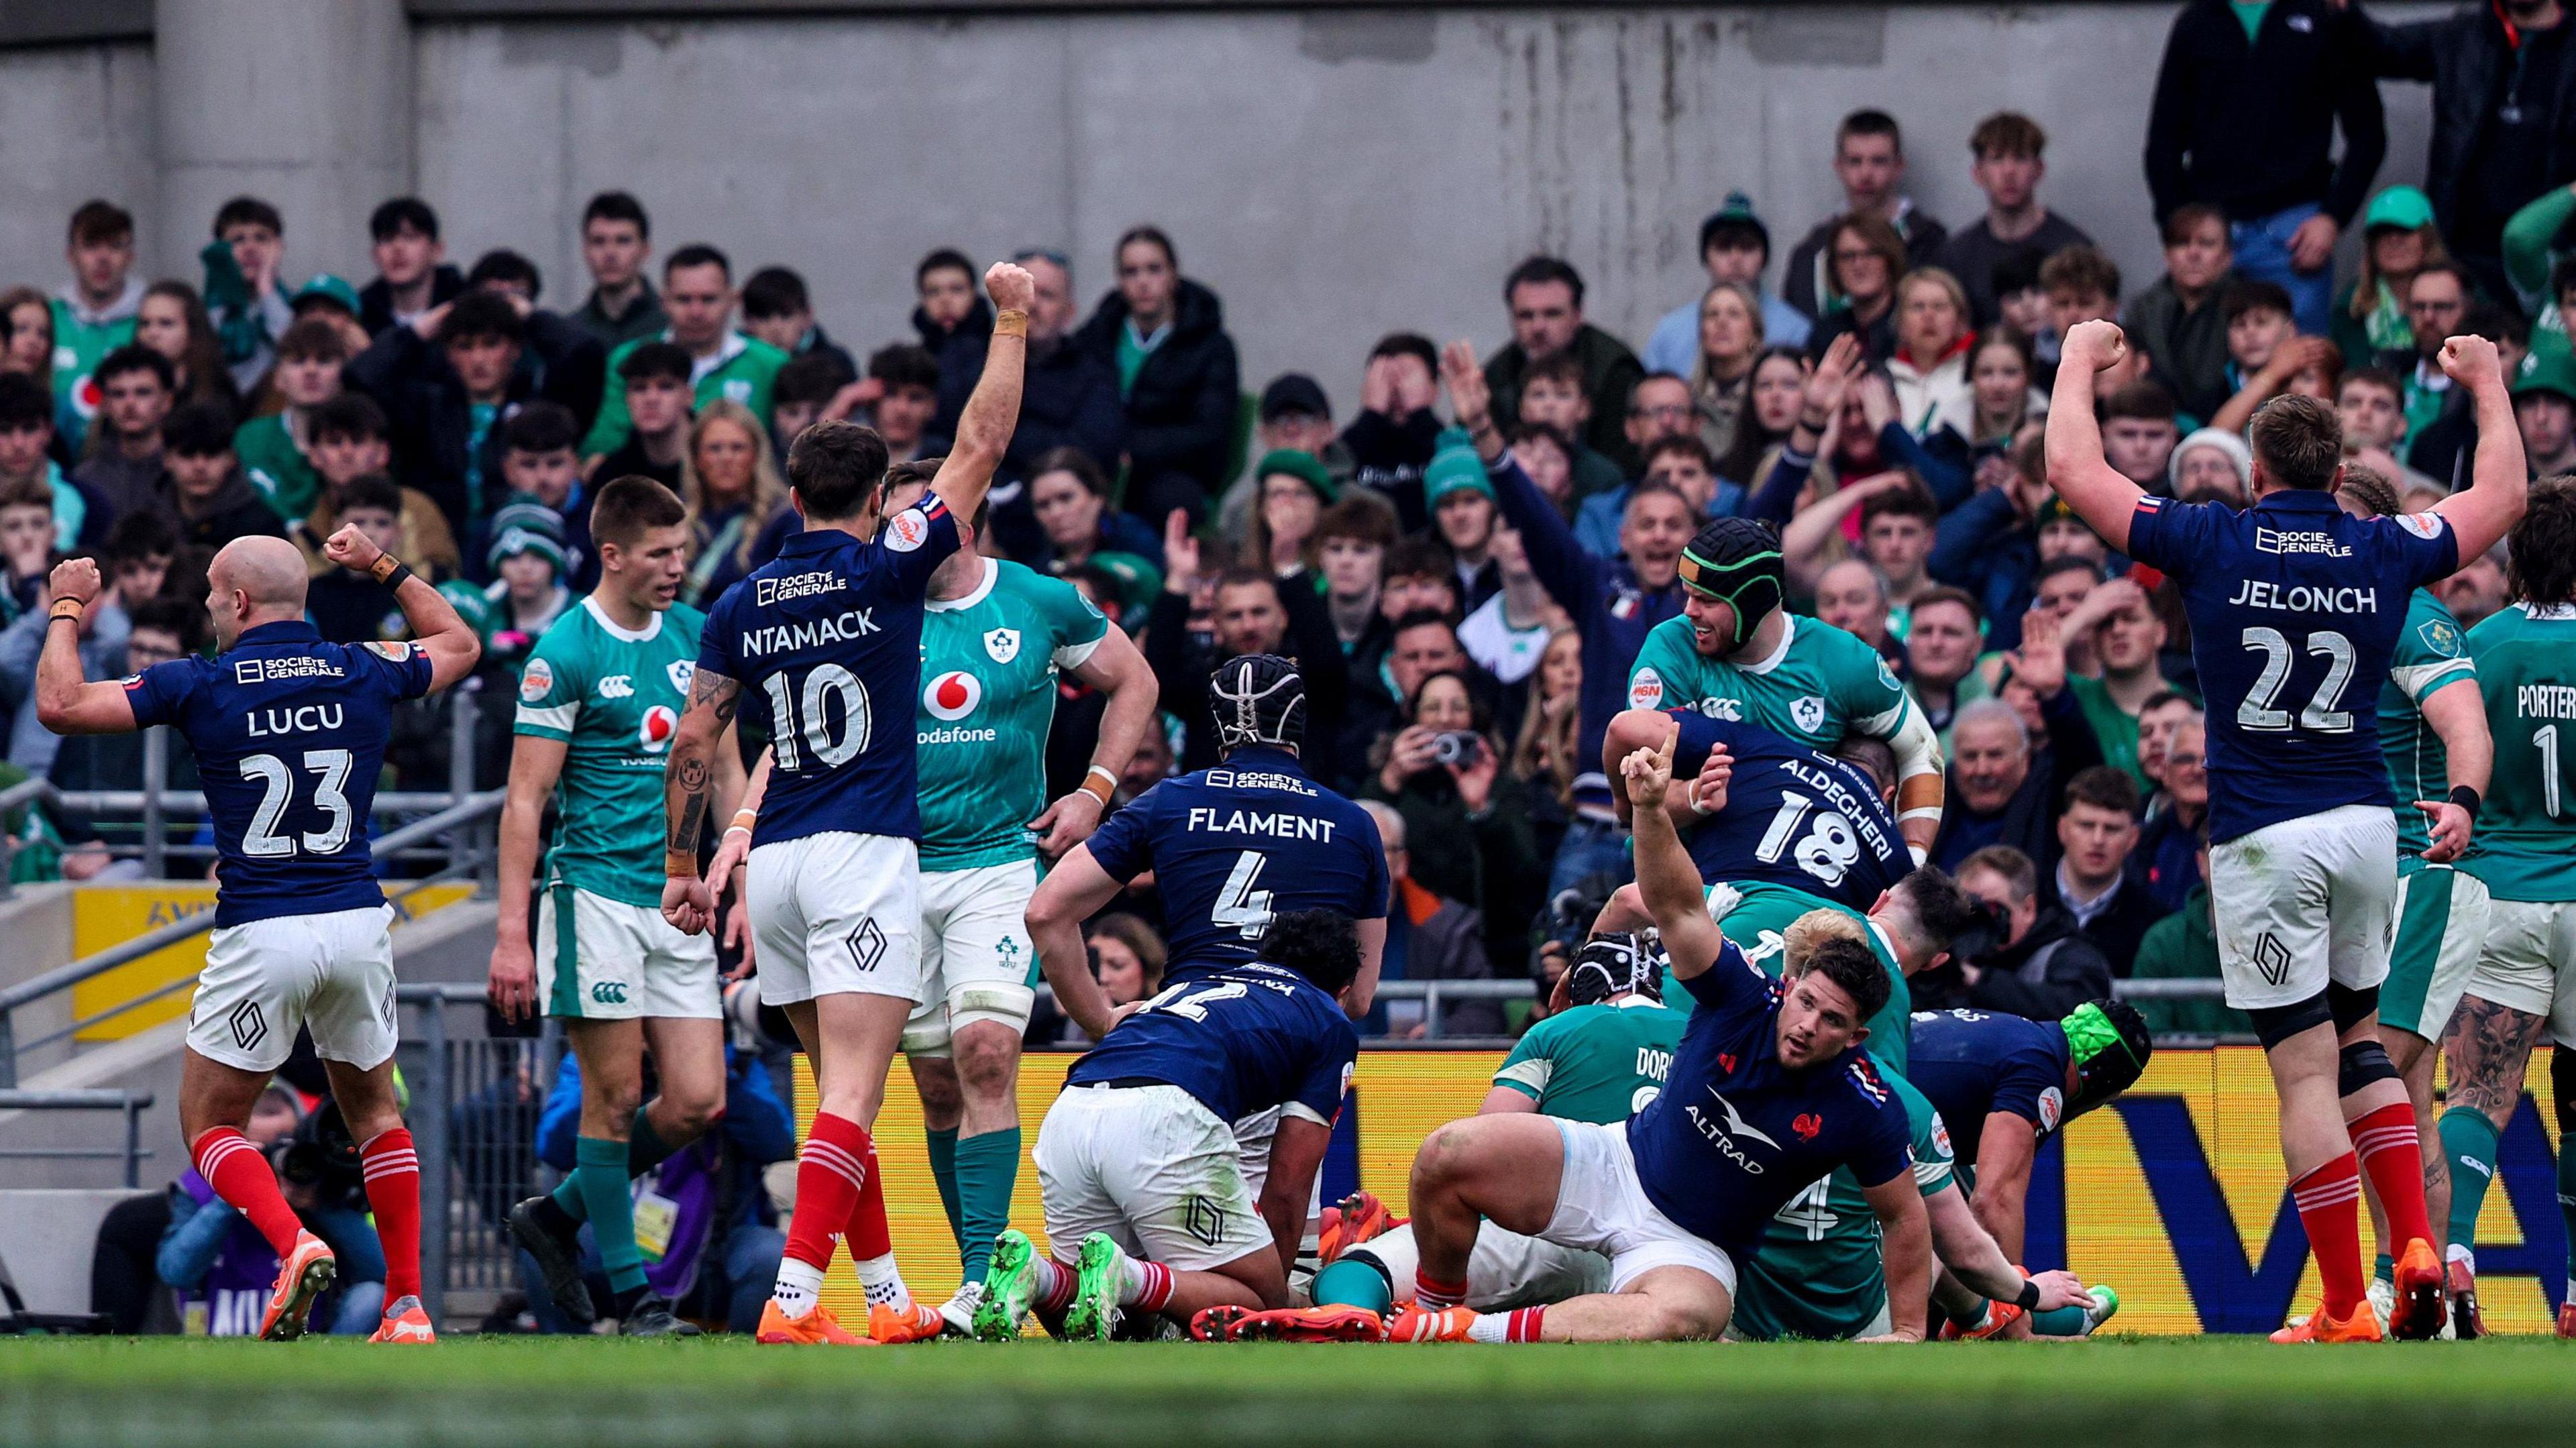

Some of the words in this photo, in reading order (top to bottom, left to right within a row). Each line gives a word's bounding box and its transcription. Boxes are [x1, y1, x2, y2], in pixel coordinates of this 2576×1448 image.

[777, 579, 846, 601] GENERALE
[779, 570, 833, 589] SOCIETE
[2229, 579, 2376, 613] JELONCH
[743, 607, 881, 657] NTAMACK
[265, 657, 329, 669] SOCIETE
[266, 667, 344, 679] GENERALE
[2237, 626, 2356, 734] 22
[763, 663, 871, 771] 10
[2518, 685, 2576, 719] PORTER
[247, 704, 343, 736] LUCU
[917, 727, 996, 744] odafone
[1236, 780, 1318, 797] GENERALE
[1237, 773, 1302, 787] SOCIETE
[2533, 724, 2559, 818] 1
[239, 749, 352, 858] 23
[1779, 759, 1893, 862] ALDEGHERI
[1188, 808, 1336, 843] FLAMENT
[1755, 790, 1860, 887] 18
[1212, 850, 1277, 940] 4
[1135, 981, 1248, 1023] 12
[1685, 1105, 1764, 1174] ALTRAD
